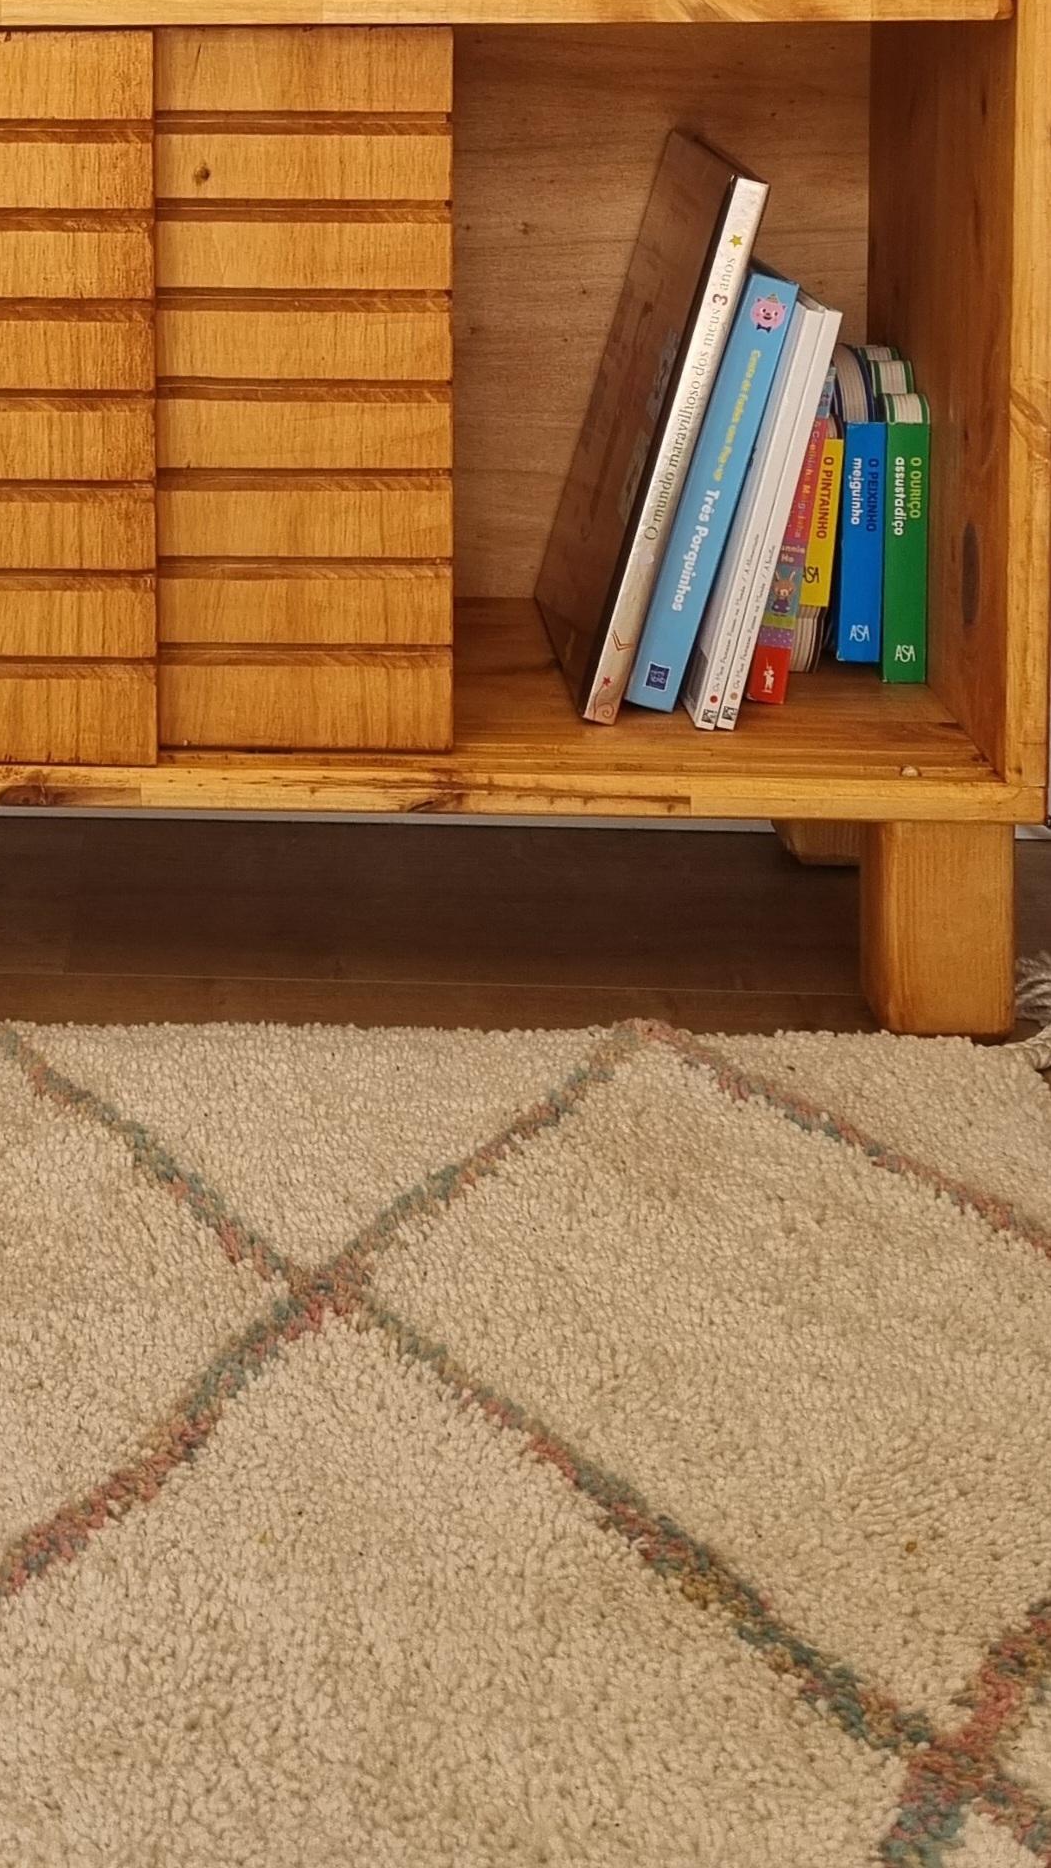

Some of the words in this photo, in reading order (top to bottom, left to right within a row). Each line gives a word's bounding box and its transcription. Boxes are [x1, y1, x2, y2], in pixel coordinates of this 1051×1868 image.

[719, 257, 736, 292] anos
[712, 293, 728, 306] 3
[703, 308, 722, 347] meus
[692, 351, 709, 377] dos
[669, 380, 701, 470] maravilhoso
[823, 456, 835, 466] O
[868, 458, 879, 469] O
[910, 456, 922, 467] O
[653, 471, 676, 523] mundo
[698, 489, 720, 522] Três
[816, 470, 833, 539] PINTAINHO
[848, 457, 865, 525] meiguinho
[866, 472, 879, 532] PEIXINHO
[891, 456, 907, 536] assustadiço
[907, 470, 922, 519] OURIÇO
[644, 526, 659, 541] O
[672, 525, 710, 612] Porquinhos
[849, 624, 870, 642] ASA
[894, 644, 916, 663] ASA
